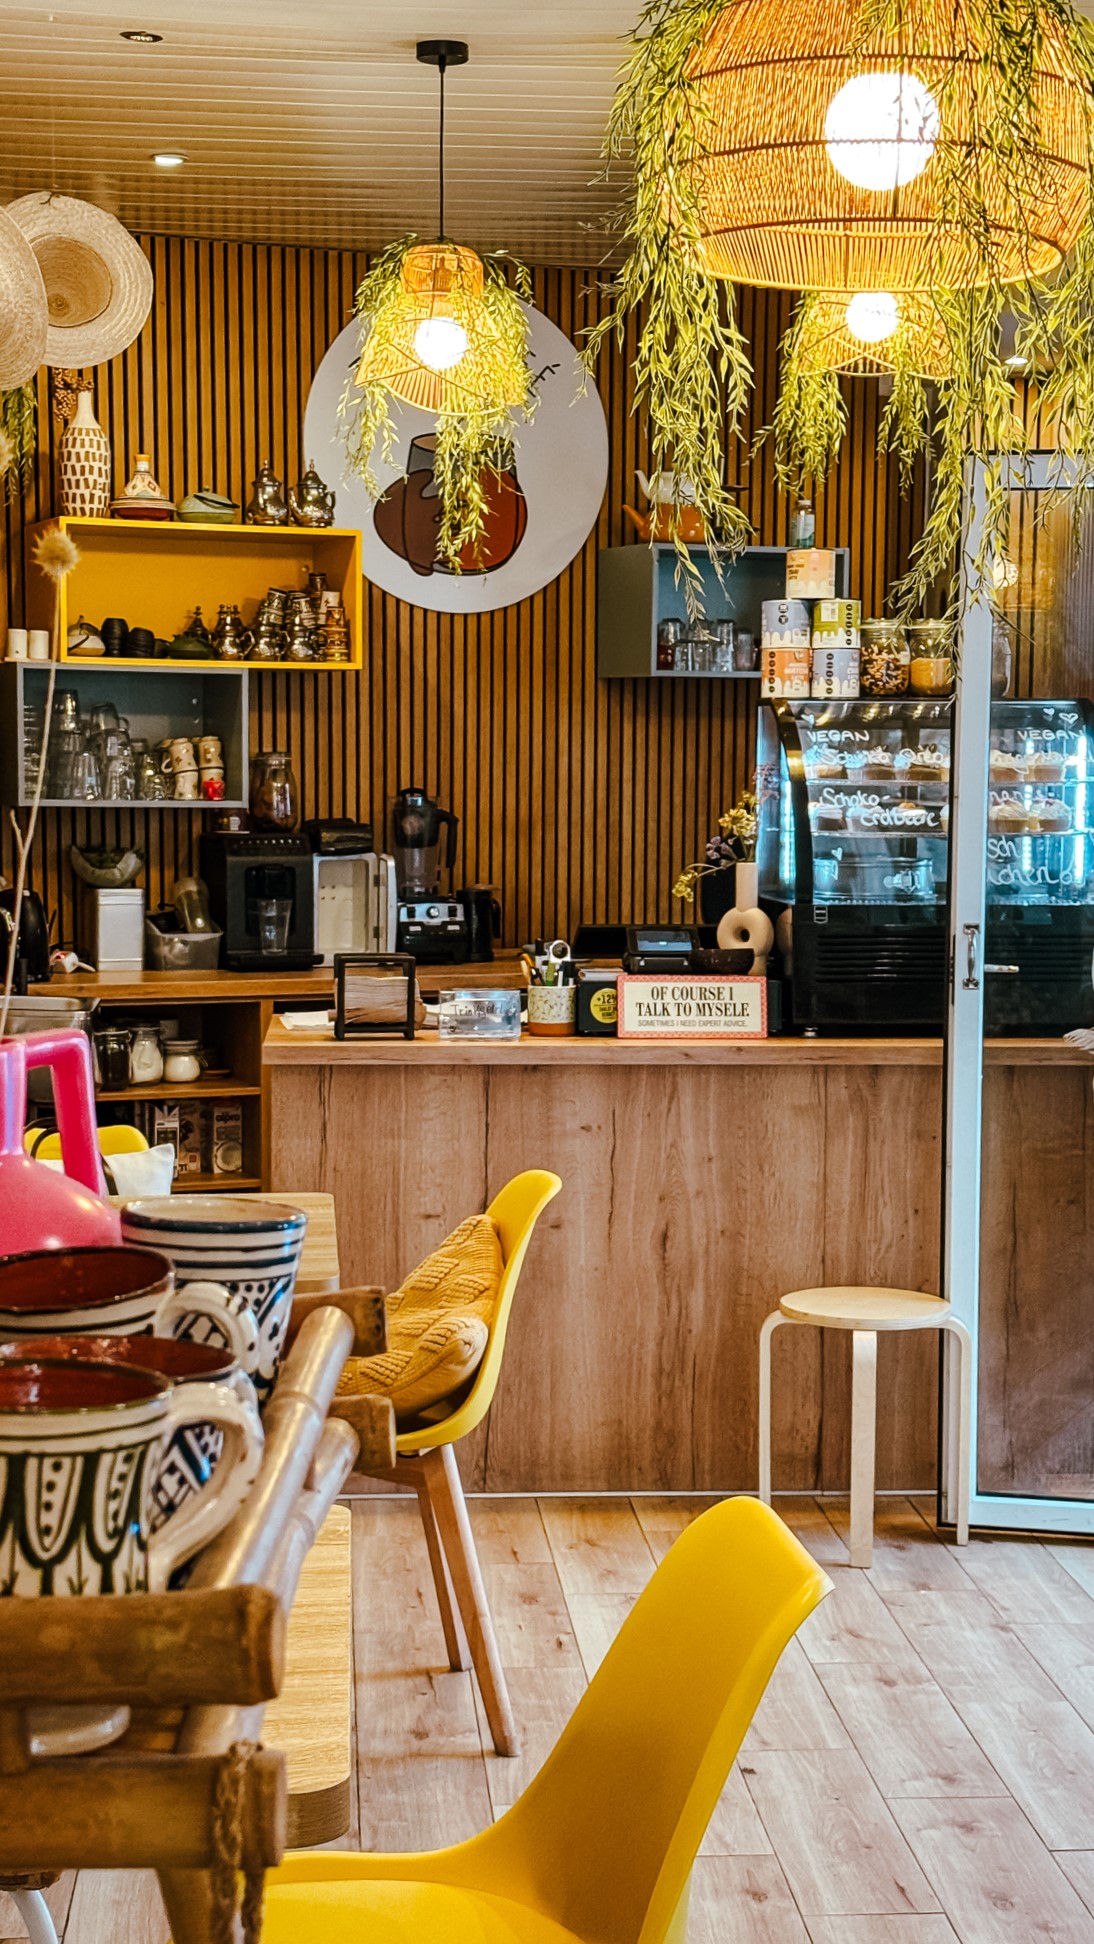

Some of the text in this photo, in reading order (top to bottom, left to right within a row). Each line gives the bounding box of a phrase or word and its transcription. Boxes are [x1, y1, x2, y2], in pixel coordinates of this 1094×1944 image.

[807, 730, 870, 742] VEGAN
[1017, 726, 1087, 741] VEGAN
[819, 787, 891, 807] Schoko-
[650, 985, 734, 1001] OF COURSE I
[635, 1002, 750, 1017] TALK TO MYSELF.
[216, 1112, 240, 1123] alpro
